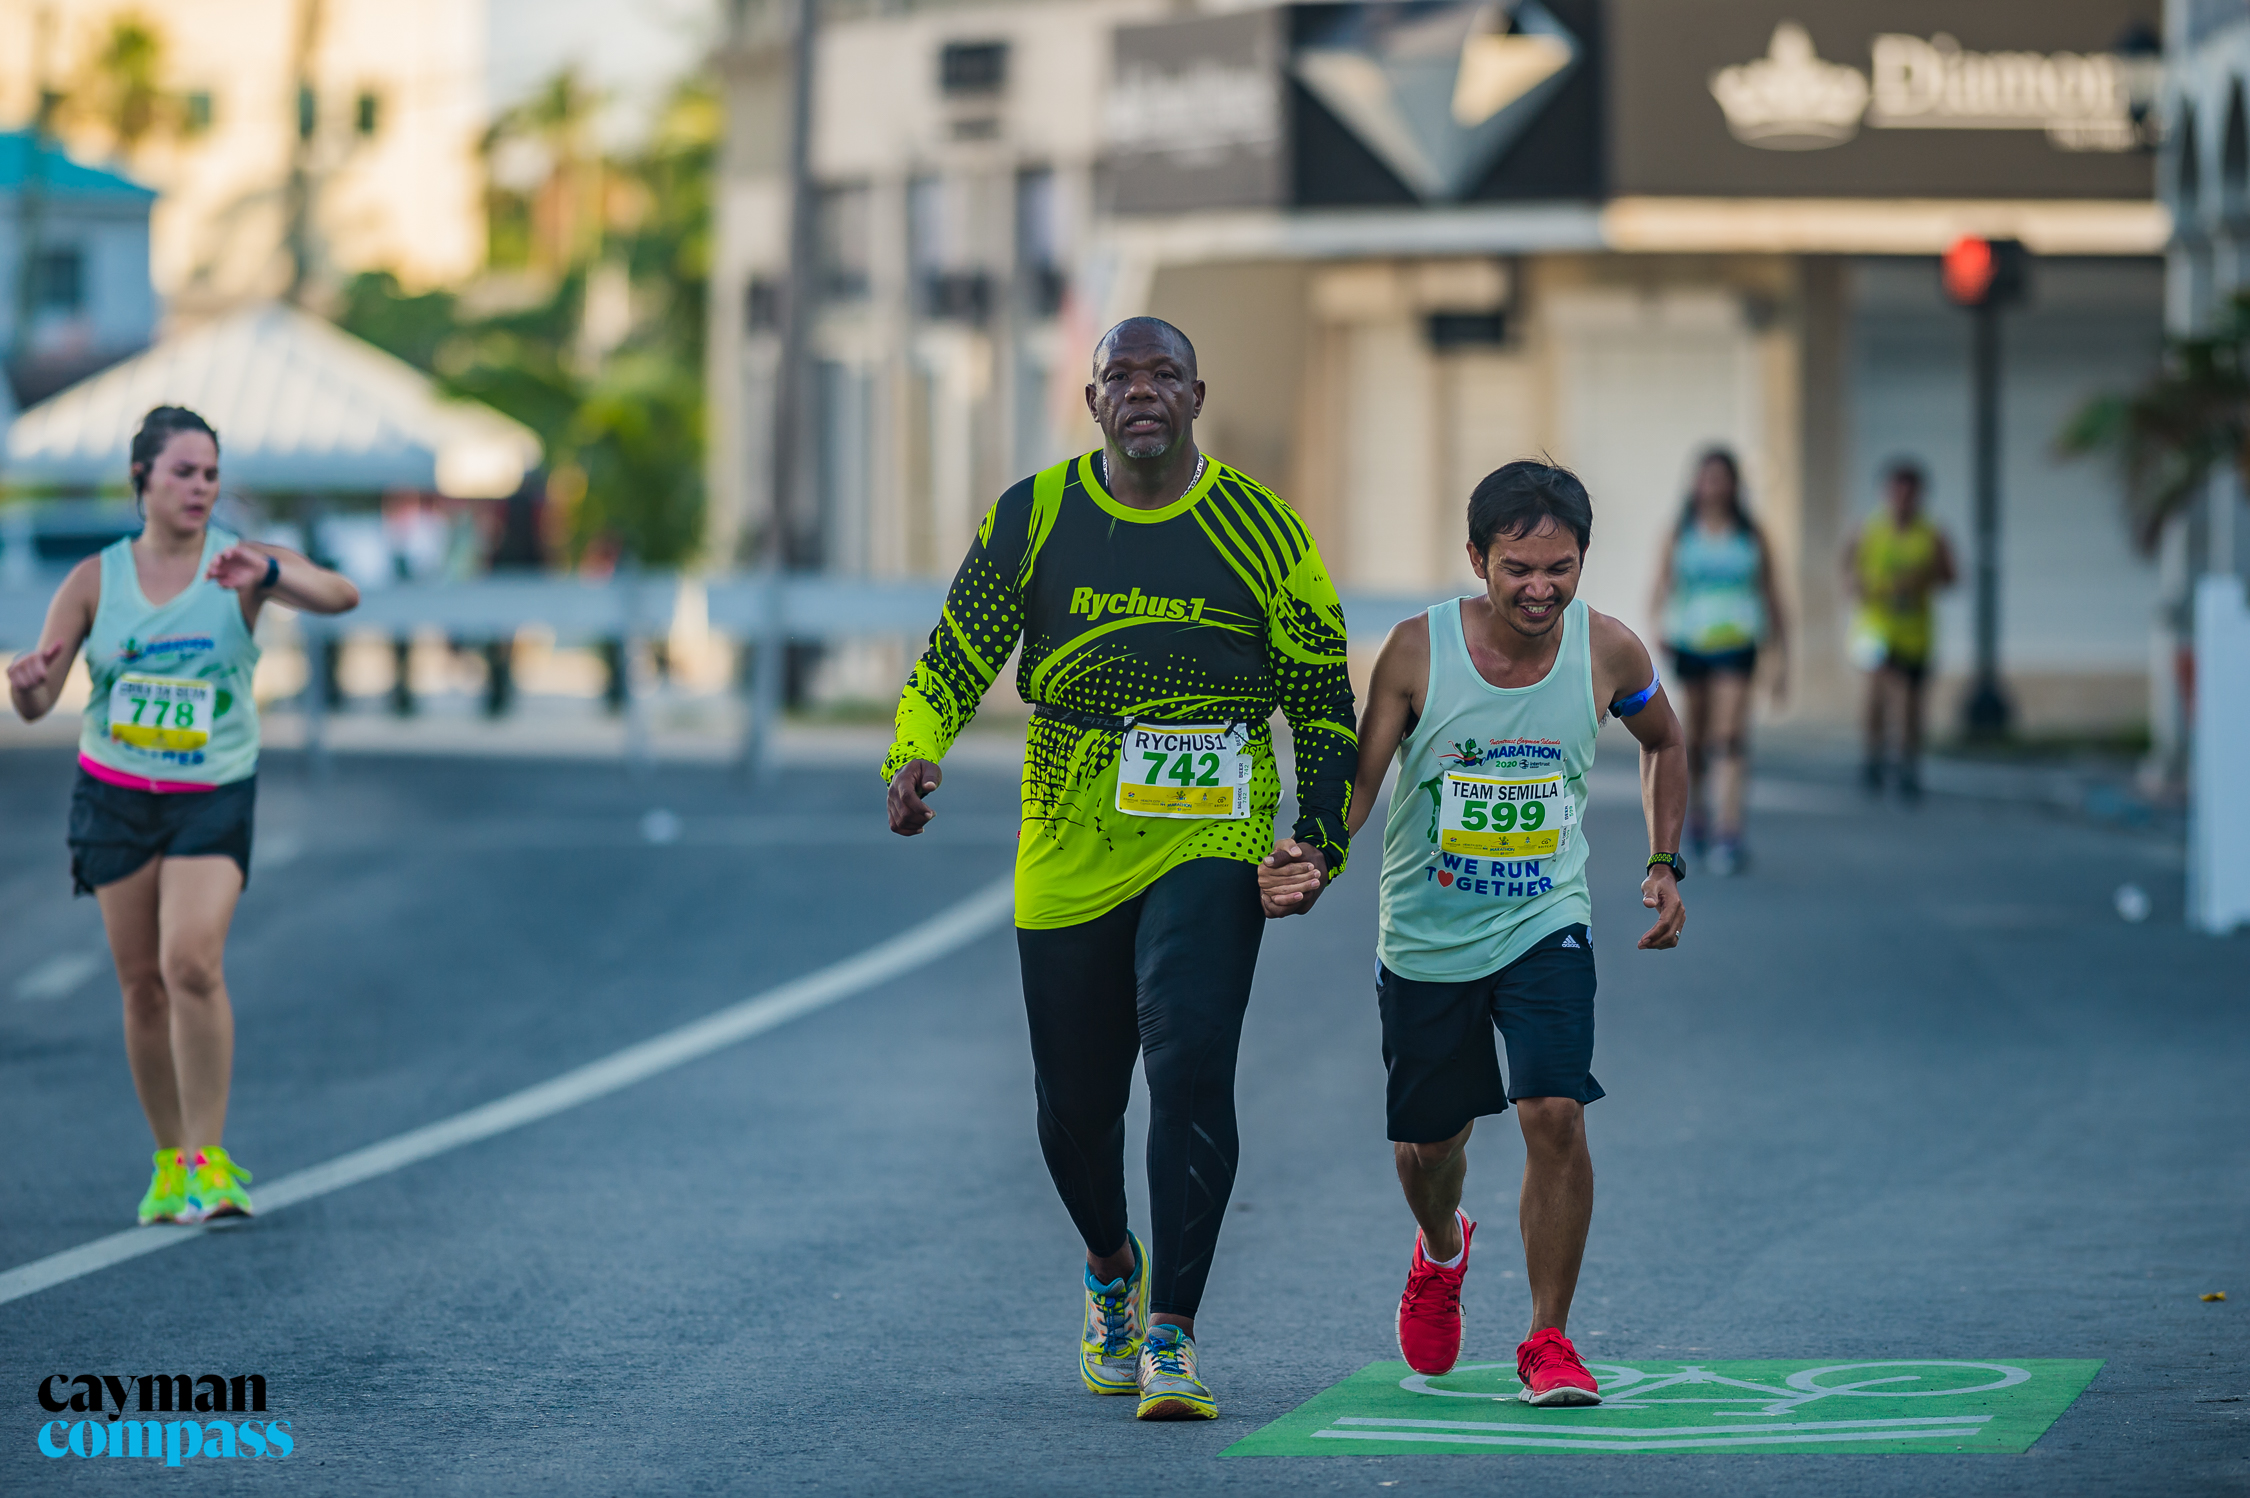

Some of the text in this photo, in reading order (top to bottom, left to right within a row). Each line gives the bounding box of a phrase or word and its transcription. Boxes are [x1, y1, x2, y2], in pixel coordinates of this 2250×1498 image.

[1872, 31, 2158, 117] Diamon
[130, 698, 194, 727] 778
[1135, 731, 1227, 751] RYCHUS1
[1486, 745, 1561, 760] MARATHON
[1142, 751, 1220, 786] 742
[1452, 781, 1558, 800] TEAM SEMILLA
[1460, 800, 1546, 832] 599
[1442, 852, 1540, 878] WE RUN
